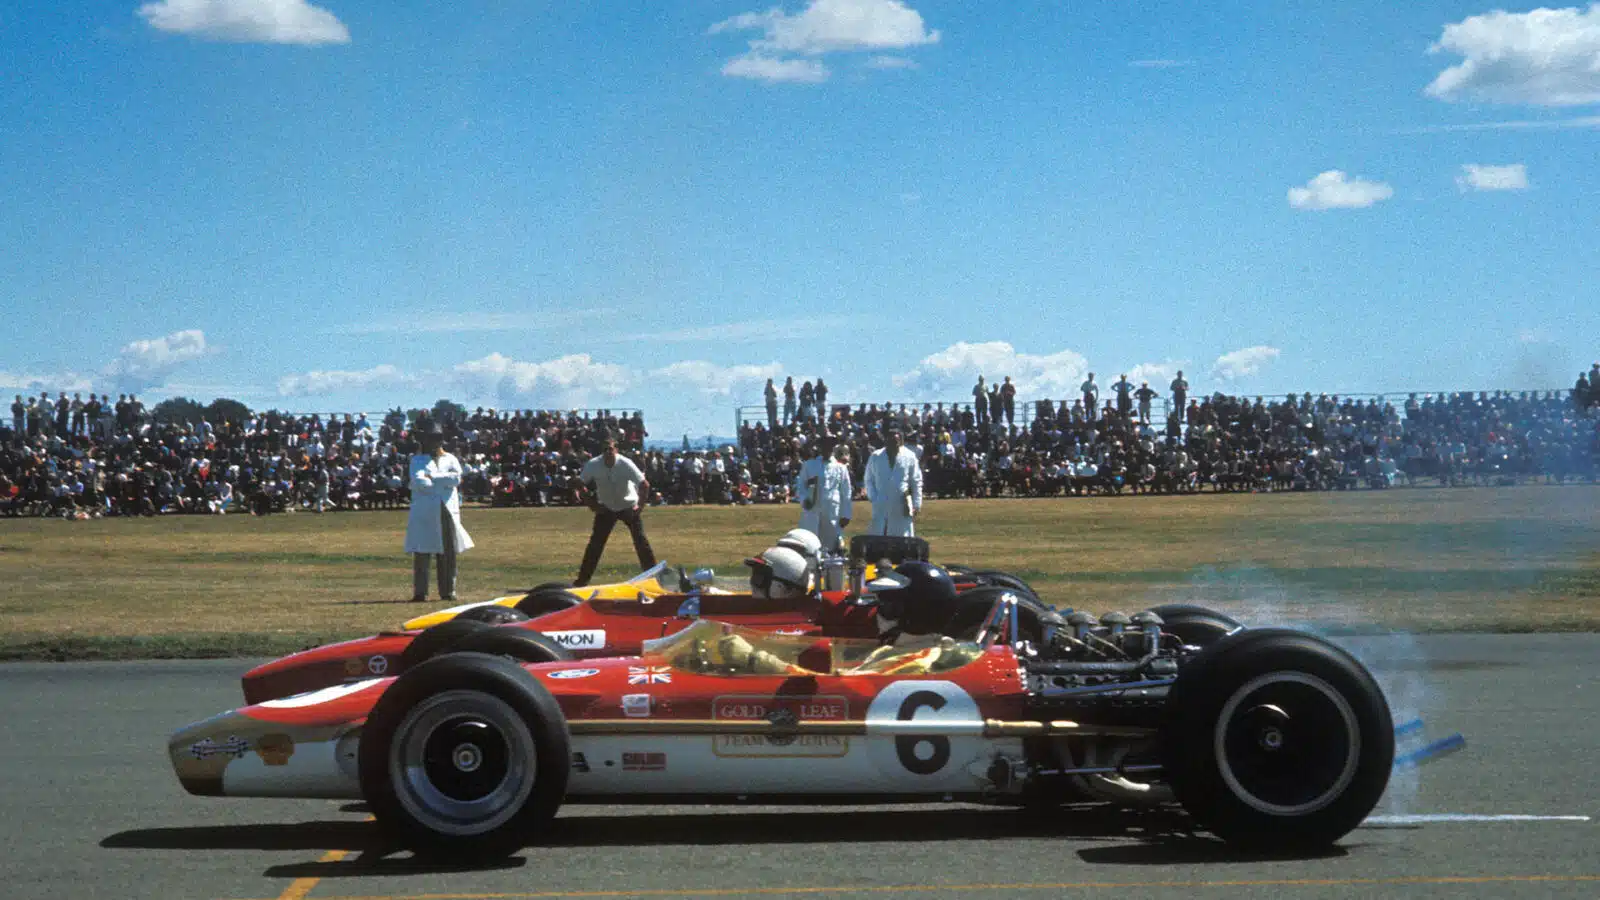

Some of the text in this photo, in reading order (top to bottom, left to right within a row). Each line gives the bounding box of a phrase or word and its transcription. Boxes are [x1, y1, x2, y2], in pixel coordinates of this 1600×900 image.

[552, 633, 594, 646] MON
[720, 704, 841, 718] GOLD LEAF
[896, 690, 951, 775] 6
[721, 734, 766, 746] TEAM
